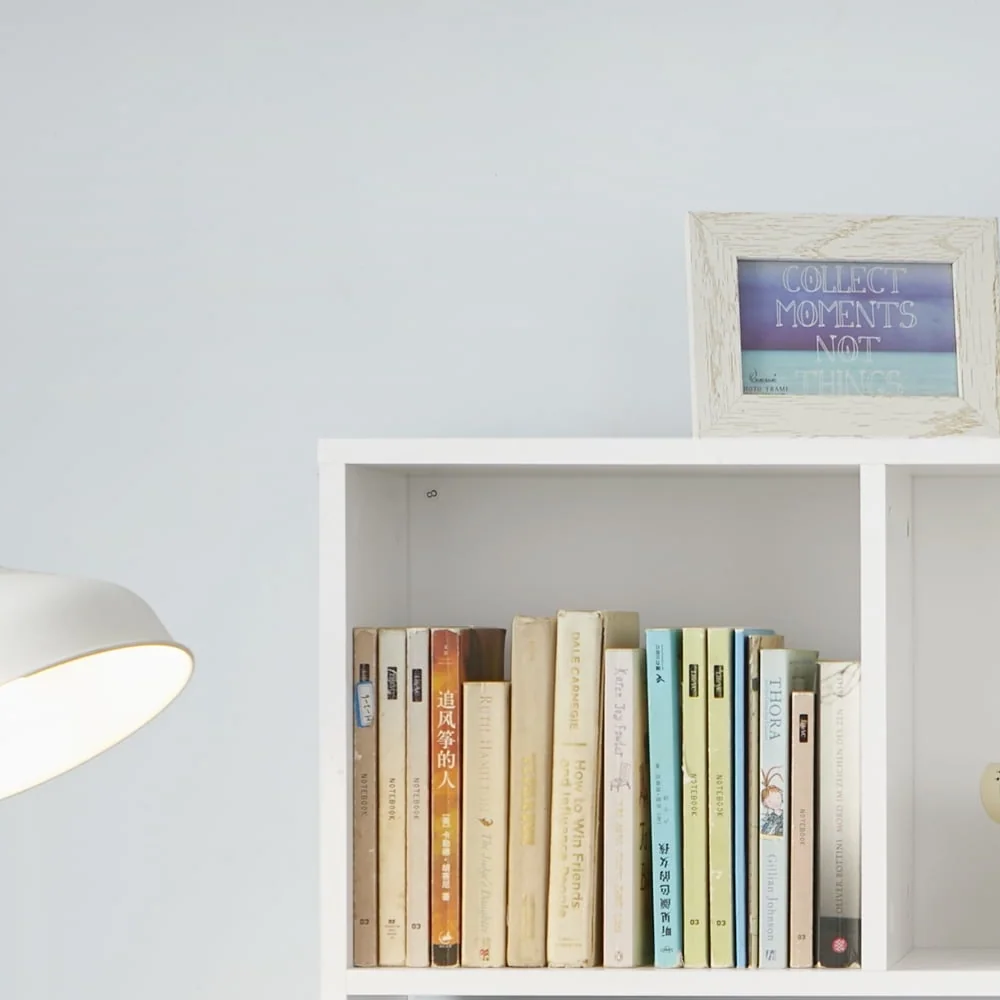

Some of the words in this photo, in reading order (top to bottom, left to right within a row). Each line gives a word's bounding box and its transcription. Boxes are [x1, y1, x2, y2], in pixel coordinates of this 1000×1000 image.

[782, 265, 907, 294] COLLECT
[775, 299, 918, 328] MOMENTS
[815, 334, 881, 363] NOT
[794, 368, 905, 396] THINGS
[569, 631, 581, 665] DALE
[568, 667, 581, 730] CARNEGIE
[614, 668, 627, 698] Karen
[768, 677, 781, 741] THORA
[436, 690, 456, 789] 追风筝的人
[359, 773, 369, 817] NOTEBOOK
[574, 759, 587, 793] How
[690, 772, 699, 817] NOTEBOOK
[715, 774, 724, 818] NOTEBOOK
[387, 777, 396, 822] NOTEBOOK
[411, 777, 420, 821] NOTEBOOK
[574, 798, 586, 813] to
[573, 818, 586, 848] Win
[570, 853, 585, 909] Friends
[658, 842, 672, 937] 听见颜色的女孩
[767, 854, 778, 893] Gillian
[767, 896, 778, 941] Johnson
